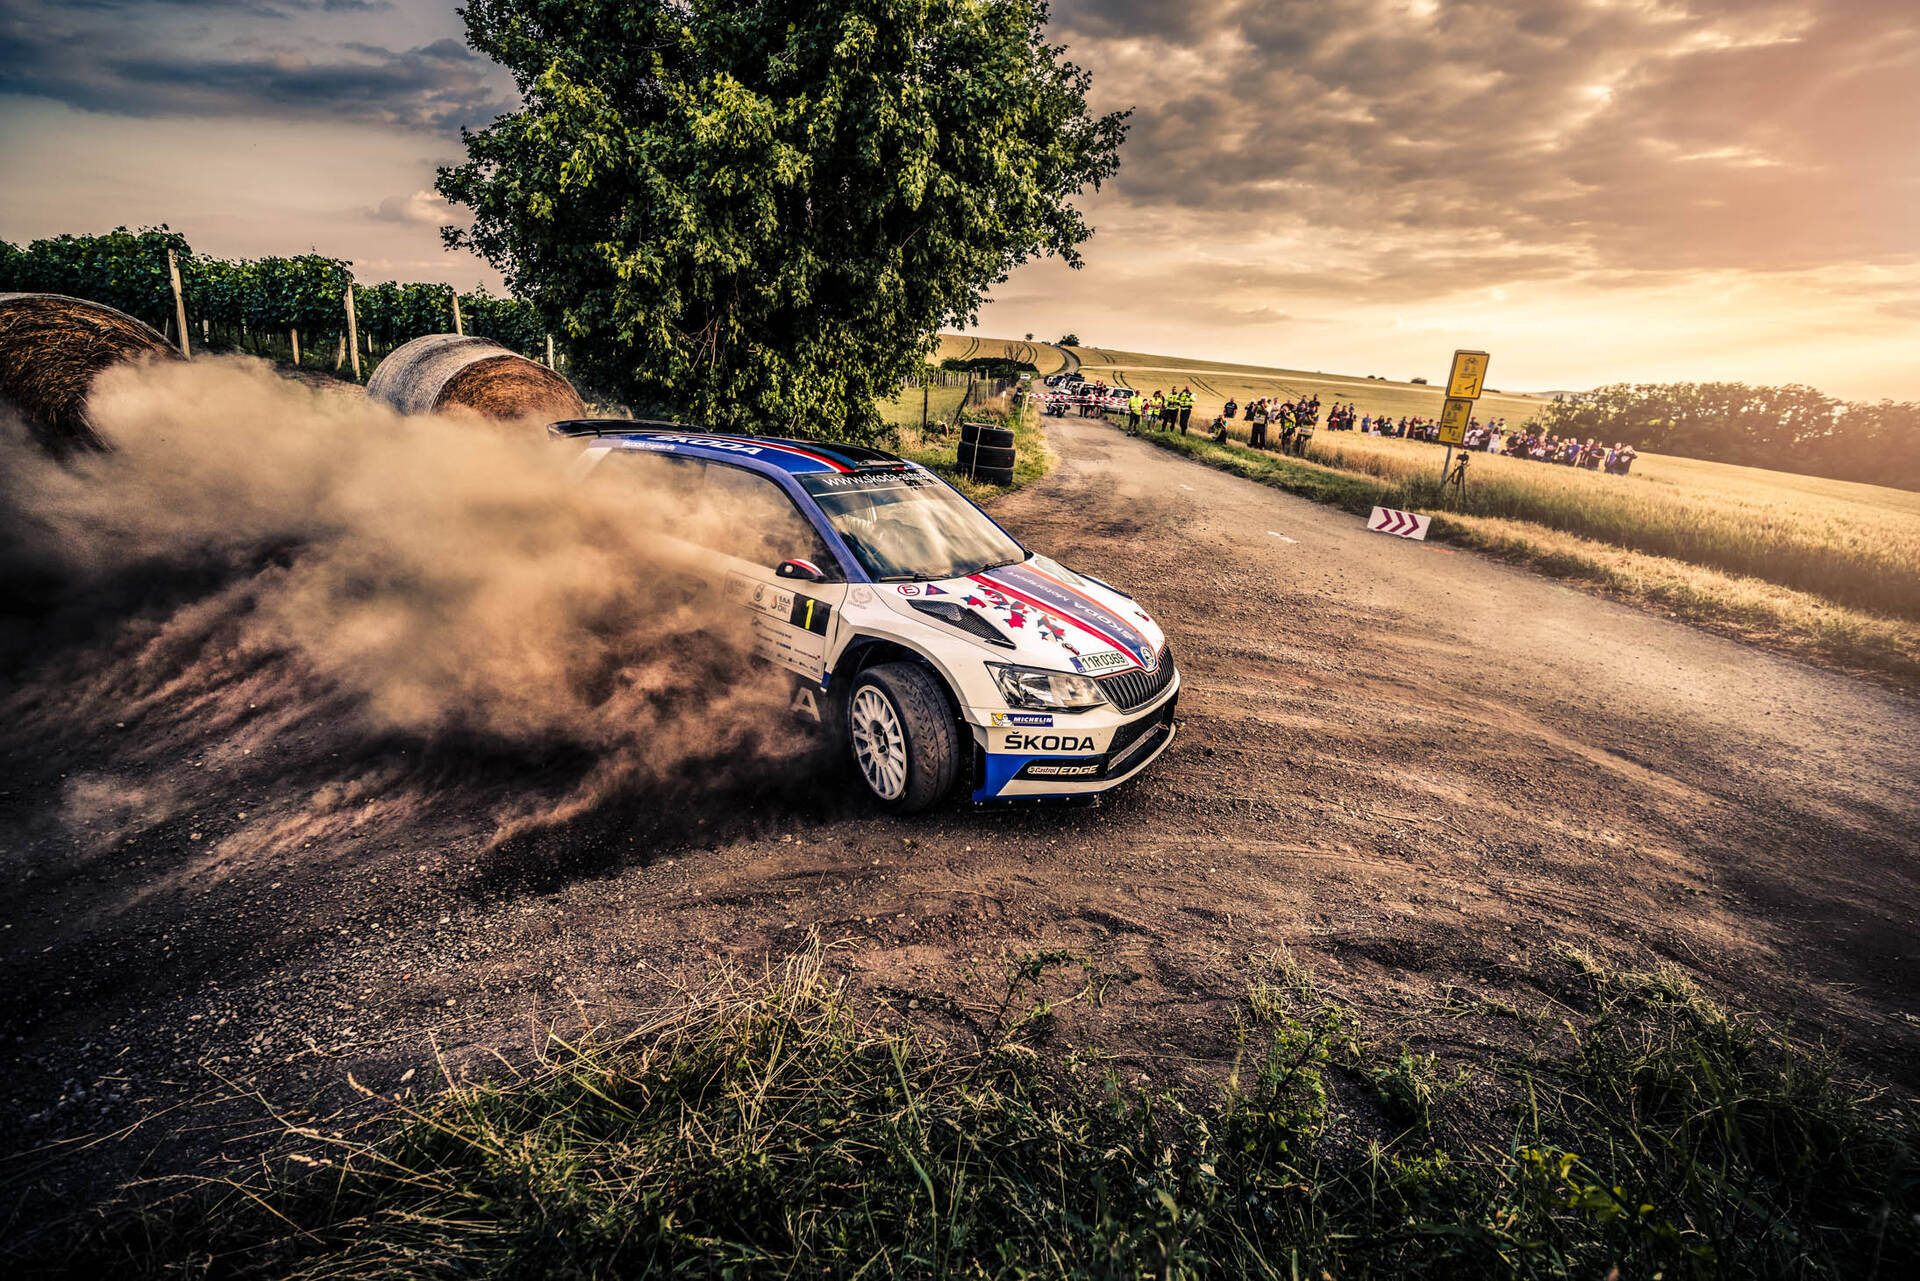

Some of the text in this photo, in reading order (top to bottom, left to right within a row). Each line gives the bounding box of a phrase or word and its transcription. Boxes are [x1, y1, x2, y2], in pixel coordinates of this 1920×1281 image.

[1006, 571, 1070, 601] Motorsport
[805, 598, 815, 629] 1
[1013, 716, 1053, 724] MICHELIN
[1004, 731, 1096, 751] ŠKODA
[1034, 765, 1100, 776] Castrol EDGE
